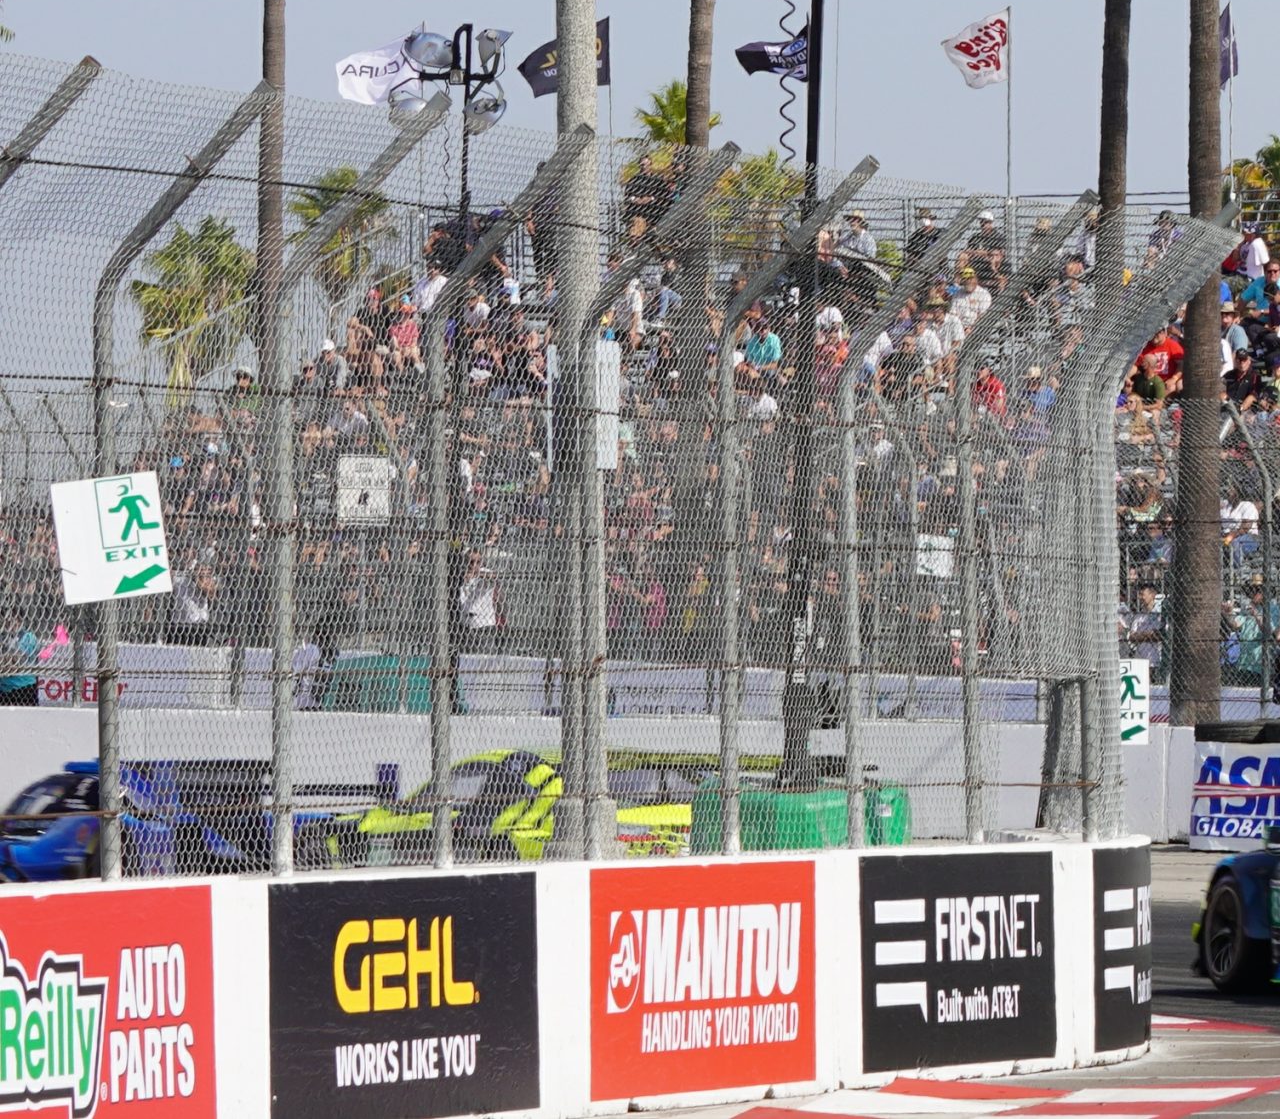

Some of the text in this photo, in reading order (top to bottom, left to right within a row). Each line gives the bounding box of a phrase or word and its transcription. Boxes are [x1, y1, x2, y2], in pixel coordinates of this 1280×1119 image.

[105, 545, 164, 563] EXIT
[1120, 711, 1147, 720] XIT
[1195, 816, 1275, 838] GLOBA
[643, 902, 802, 1004] MANITOU
[936, 894, 1040, 963] FIRSTNET
[116, 943, 187, 1020] AUTO
[334, 915, 475, 1014] GEHL
[641, 1001, 799, 1054] HANDLING YOUR WORLD
[937, 984, 1021, 1023] Built with AT&T
[109, 1023, 196, 1103] PARTS
[335, 1040, 400, 1088] WORKS
[402, 1037, 440, 1082] LIKE
